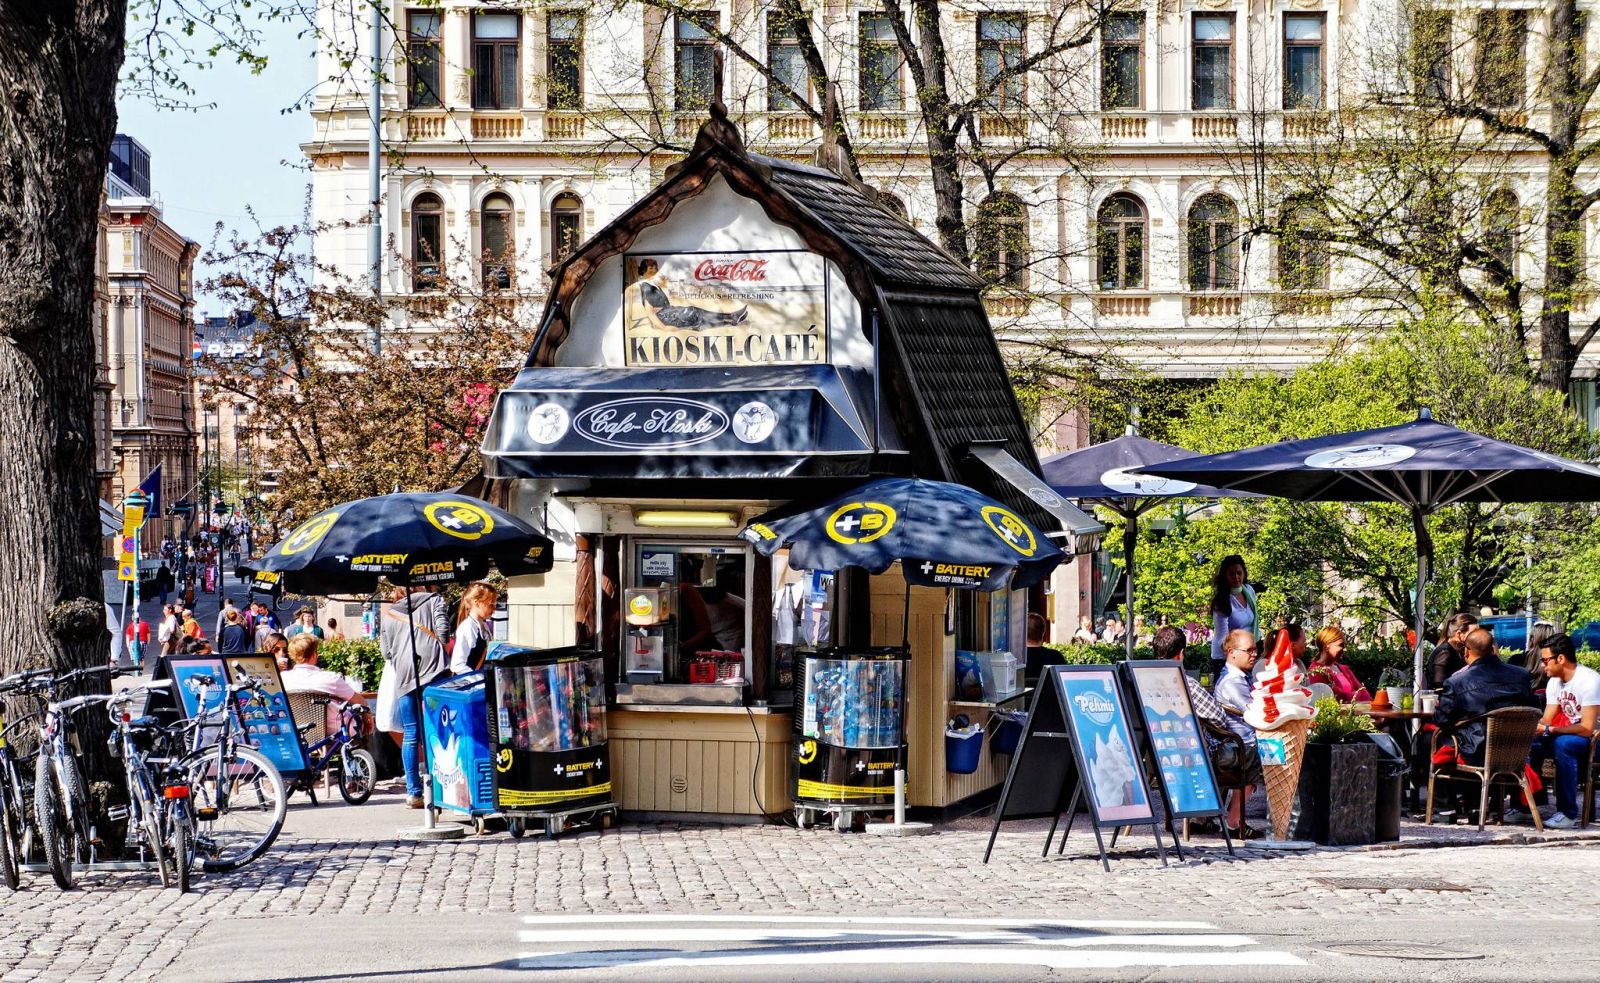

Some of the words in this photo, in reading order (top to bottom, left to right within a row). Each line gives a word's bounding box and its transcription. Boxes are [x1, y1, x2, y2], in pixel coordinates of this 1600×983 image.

[630, 325, 819, 363] KIOSKI-CAFÉ
[590, 408, 713, 440] Cafe-Kioski
[352, 553, 408, 565] BATTERY
[935, 563, 992, 578] BATTERY
[566, 761, 594, 772] BATTERY
[868, 762, 894, 770] BATTERY
